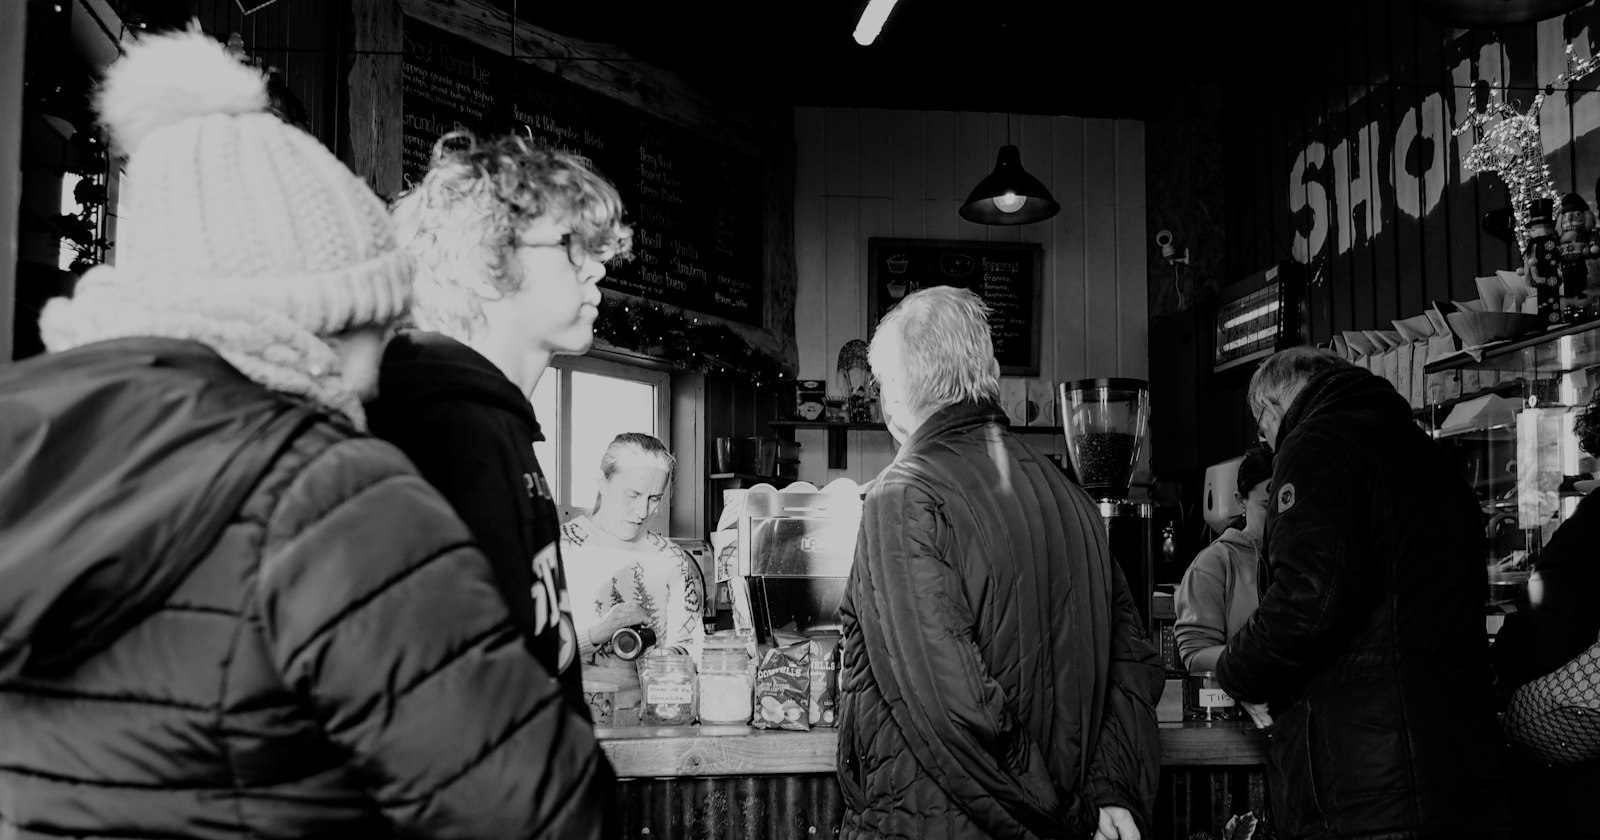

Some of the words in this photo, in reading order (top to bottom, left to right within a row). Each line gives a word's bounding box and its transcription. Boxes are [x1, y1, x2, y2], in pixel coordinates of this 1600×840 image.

[402, 62, 428, 80] oppings
[641, 248, 659, 267] Oreo
[641, 264, 664, 286] Kinder
[1205, 693, 1231, 703] TIPS
